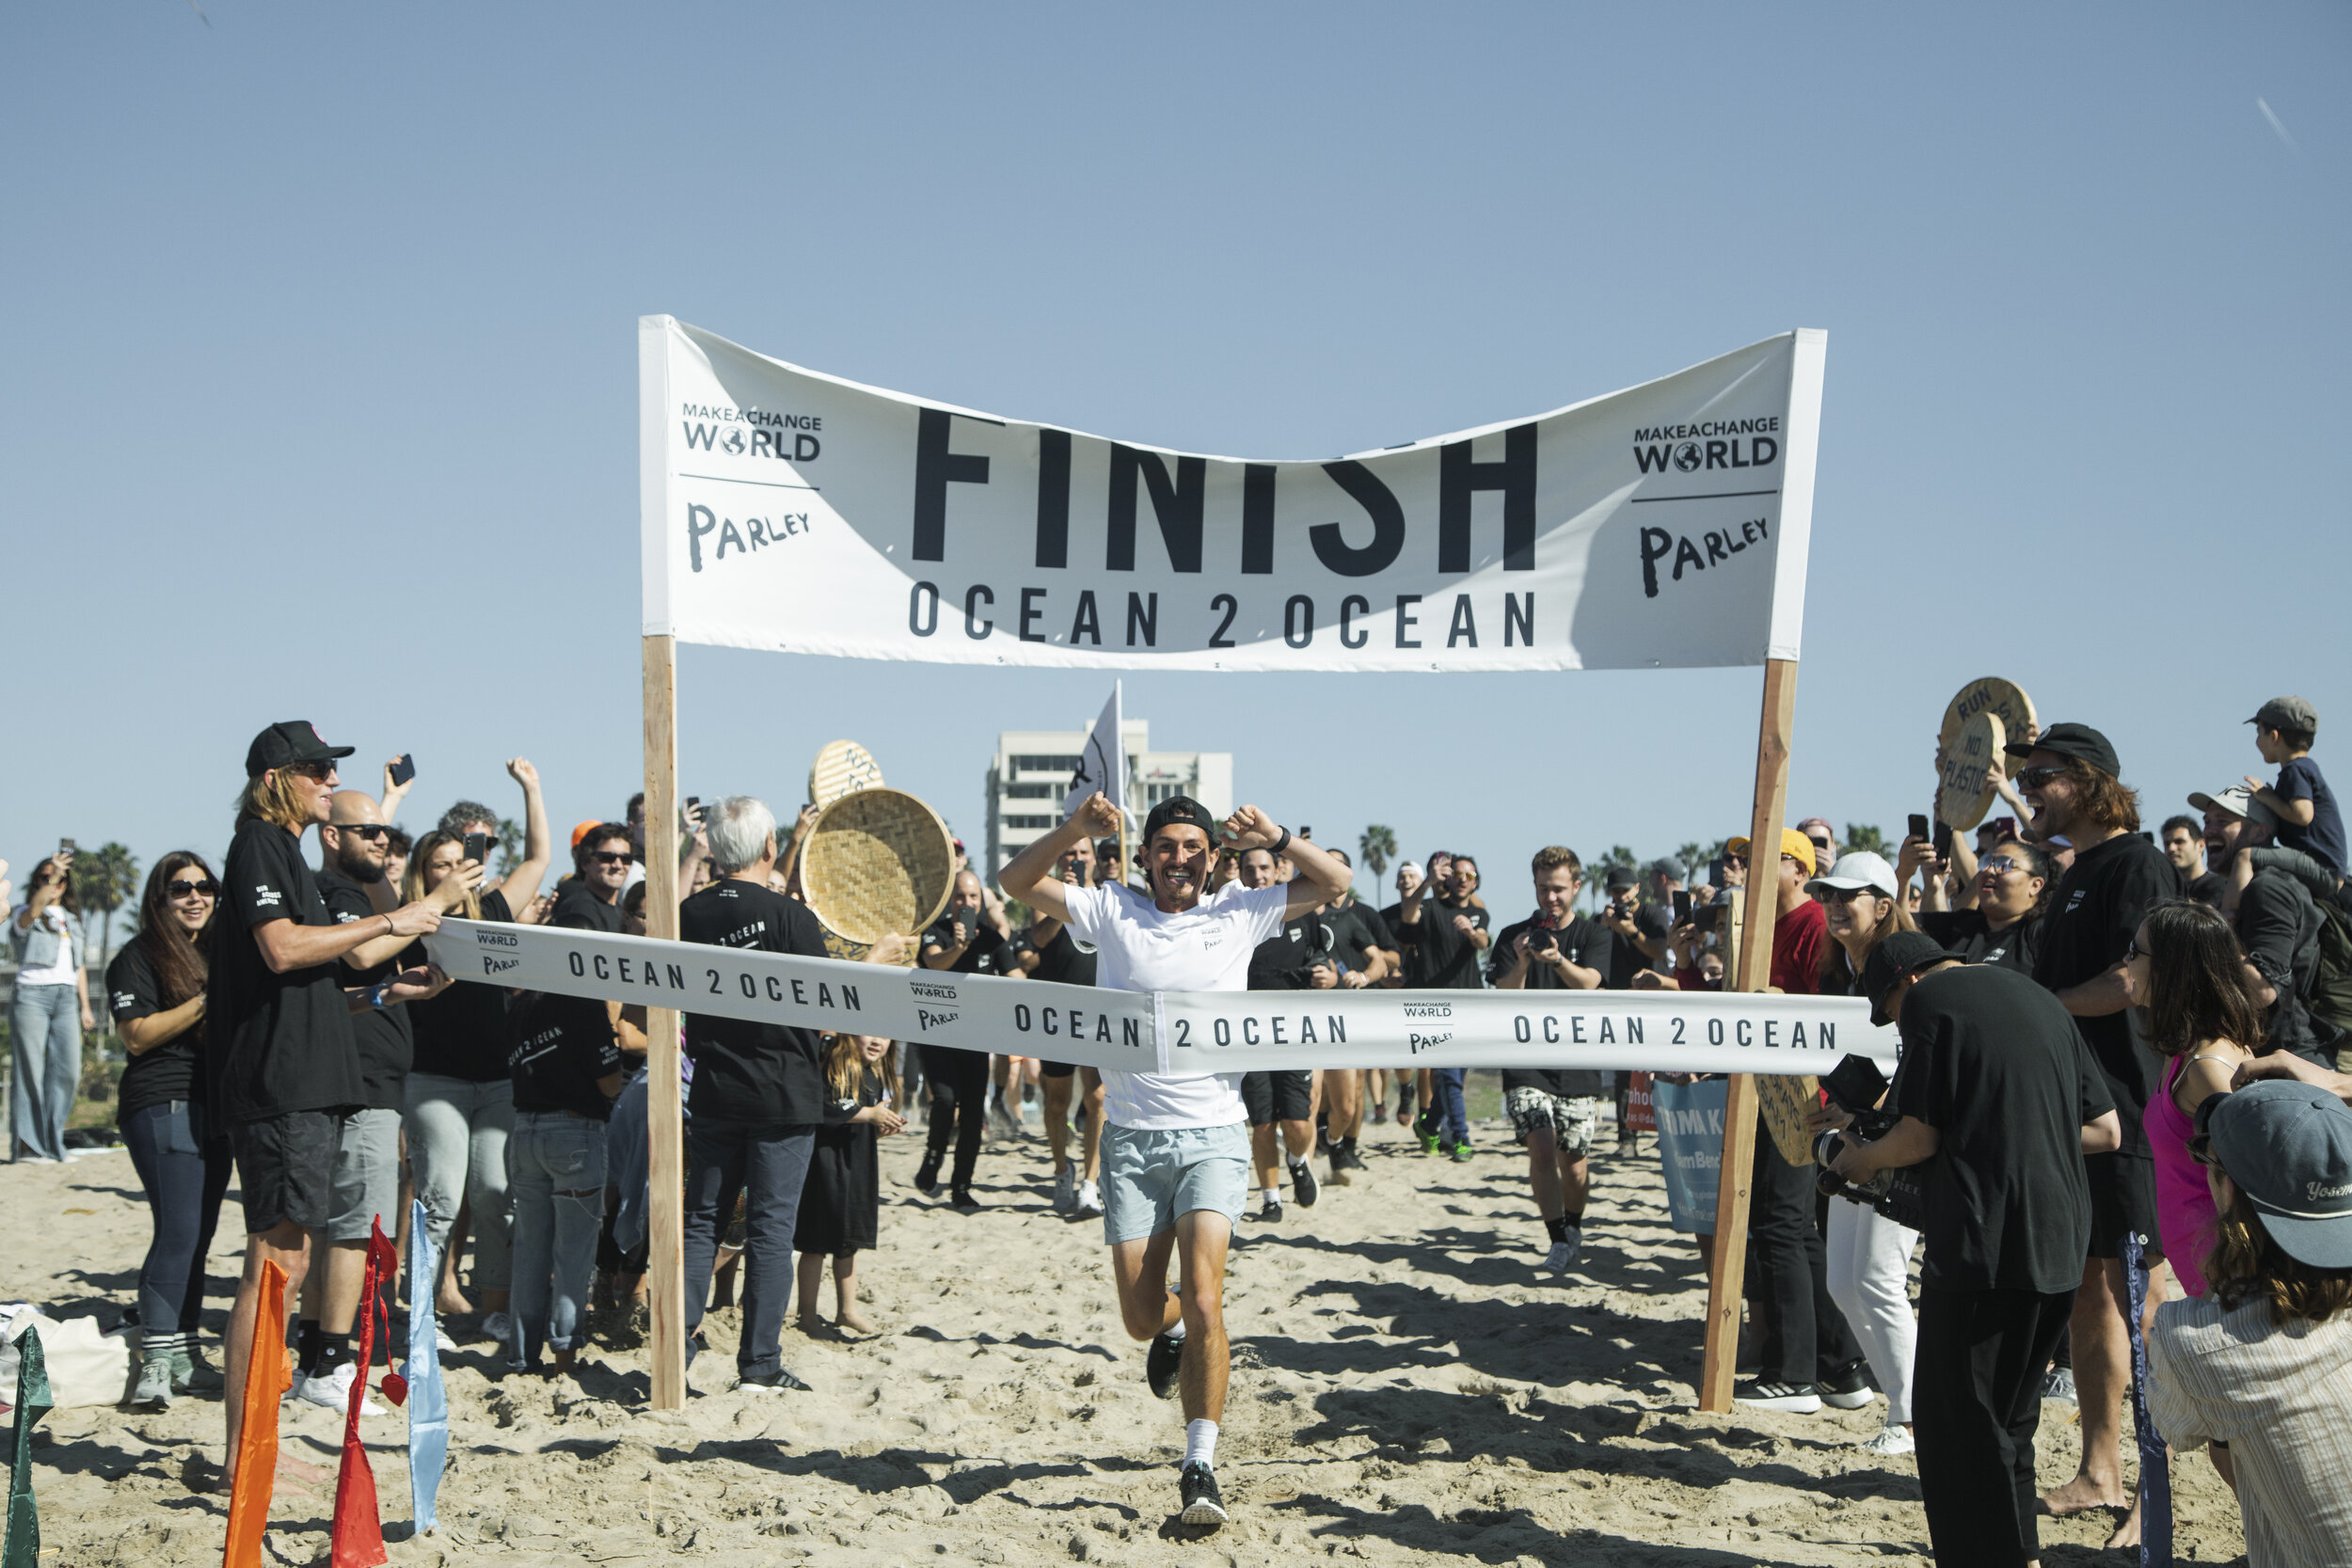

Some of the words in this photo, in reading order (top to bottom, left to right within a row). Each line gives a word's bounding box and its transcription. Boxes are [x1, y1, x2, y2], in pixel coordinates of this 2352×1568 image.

[683, 403, 822, 431] MAKEACHANGE
[1633, 417, 1780, 441] MAKEACHANGE
[682, 420, 821, 463] WORLD
[1633, 436, 1779, 474] WORLD
[912, 406, 1538, 578] FINISH
[688, 502, 810, 573] PARLEY
[1639, 517, 1768, 598] PARLEY
[909, 581, 1159, 647] OCEAN
[1209, 594, 1239, 649] 2
[1283, 592, 1535, 650] OCEAN
[1957, 687, 1993, 721] RUN
[1965, 735, 1982, 755] NO
[729, 920, 766, 943] OCEAN
[567, 951, 686, 990] OCEAN
[707, 969, 723, 995] 2
[739, 973, 861, 1011] OCEAN
[917, 1008, 960, 1031] PARLEY
[1014, 1004, 1140, 1048] OCEAN
[1175, 1019, 1192, 1048] 2
[1213, 1015, 1347, 1047] OCEAN
[1514, 1015, 1645, 1044] OCEAN
[1671, 1017, 1686, 1045] 2
[1708, 1018, 1836, 1050] OCEAN
[1409, 1032, 1454, 1054] PARLEY
